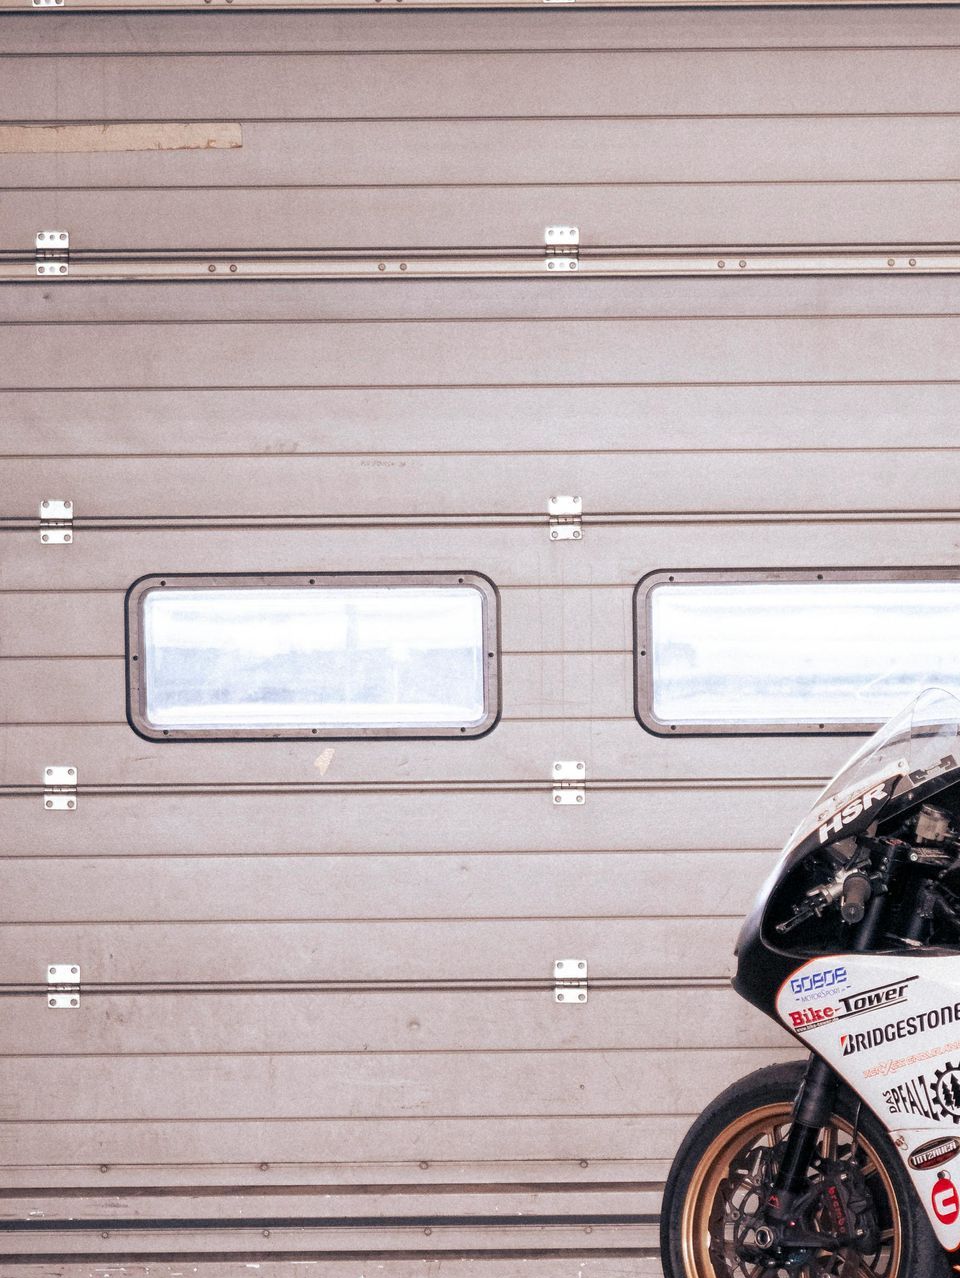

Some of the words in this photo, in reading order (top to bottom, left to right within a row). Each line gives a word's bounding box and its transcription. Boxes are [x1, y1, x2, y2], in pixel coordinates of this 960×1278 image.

[818, 782, 888, 845] HSR
[882, 1090, 897, 1114] DAS
[891, 1074, 941, 1122] PFALZ
